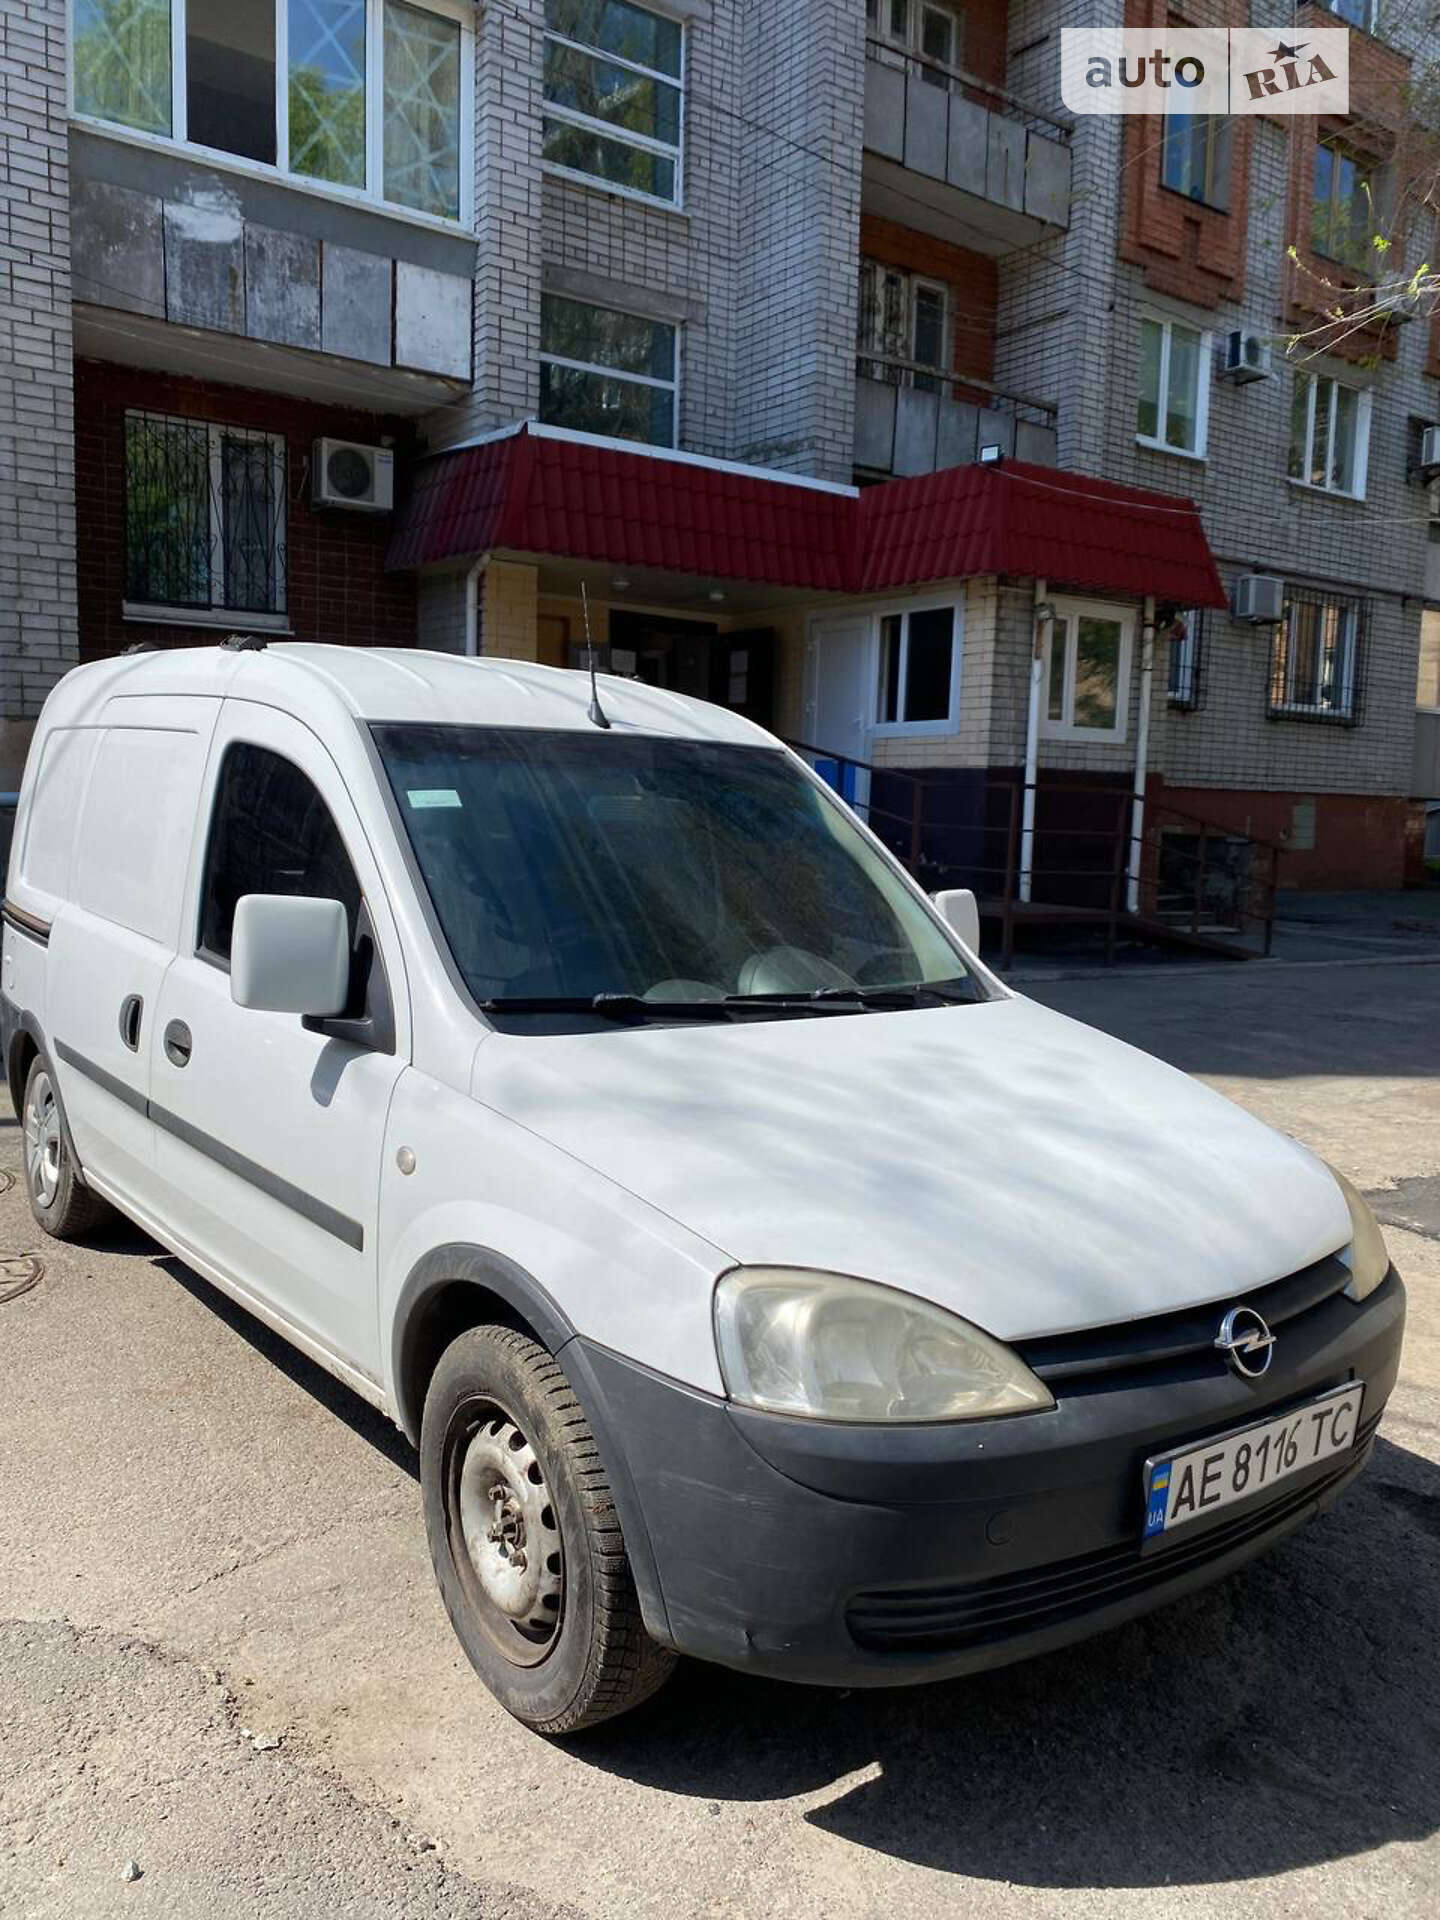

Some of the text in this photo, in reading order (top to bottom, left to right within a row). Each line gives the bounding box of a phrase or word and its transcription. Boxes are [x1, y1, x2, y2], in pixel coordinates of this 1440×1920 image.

[1170, 1401, 1352, 1519] AE 8116 TC
[1147, 1510, 1164, 1527] UA
